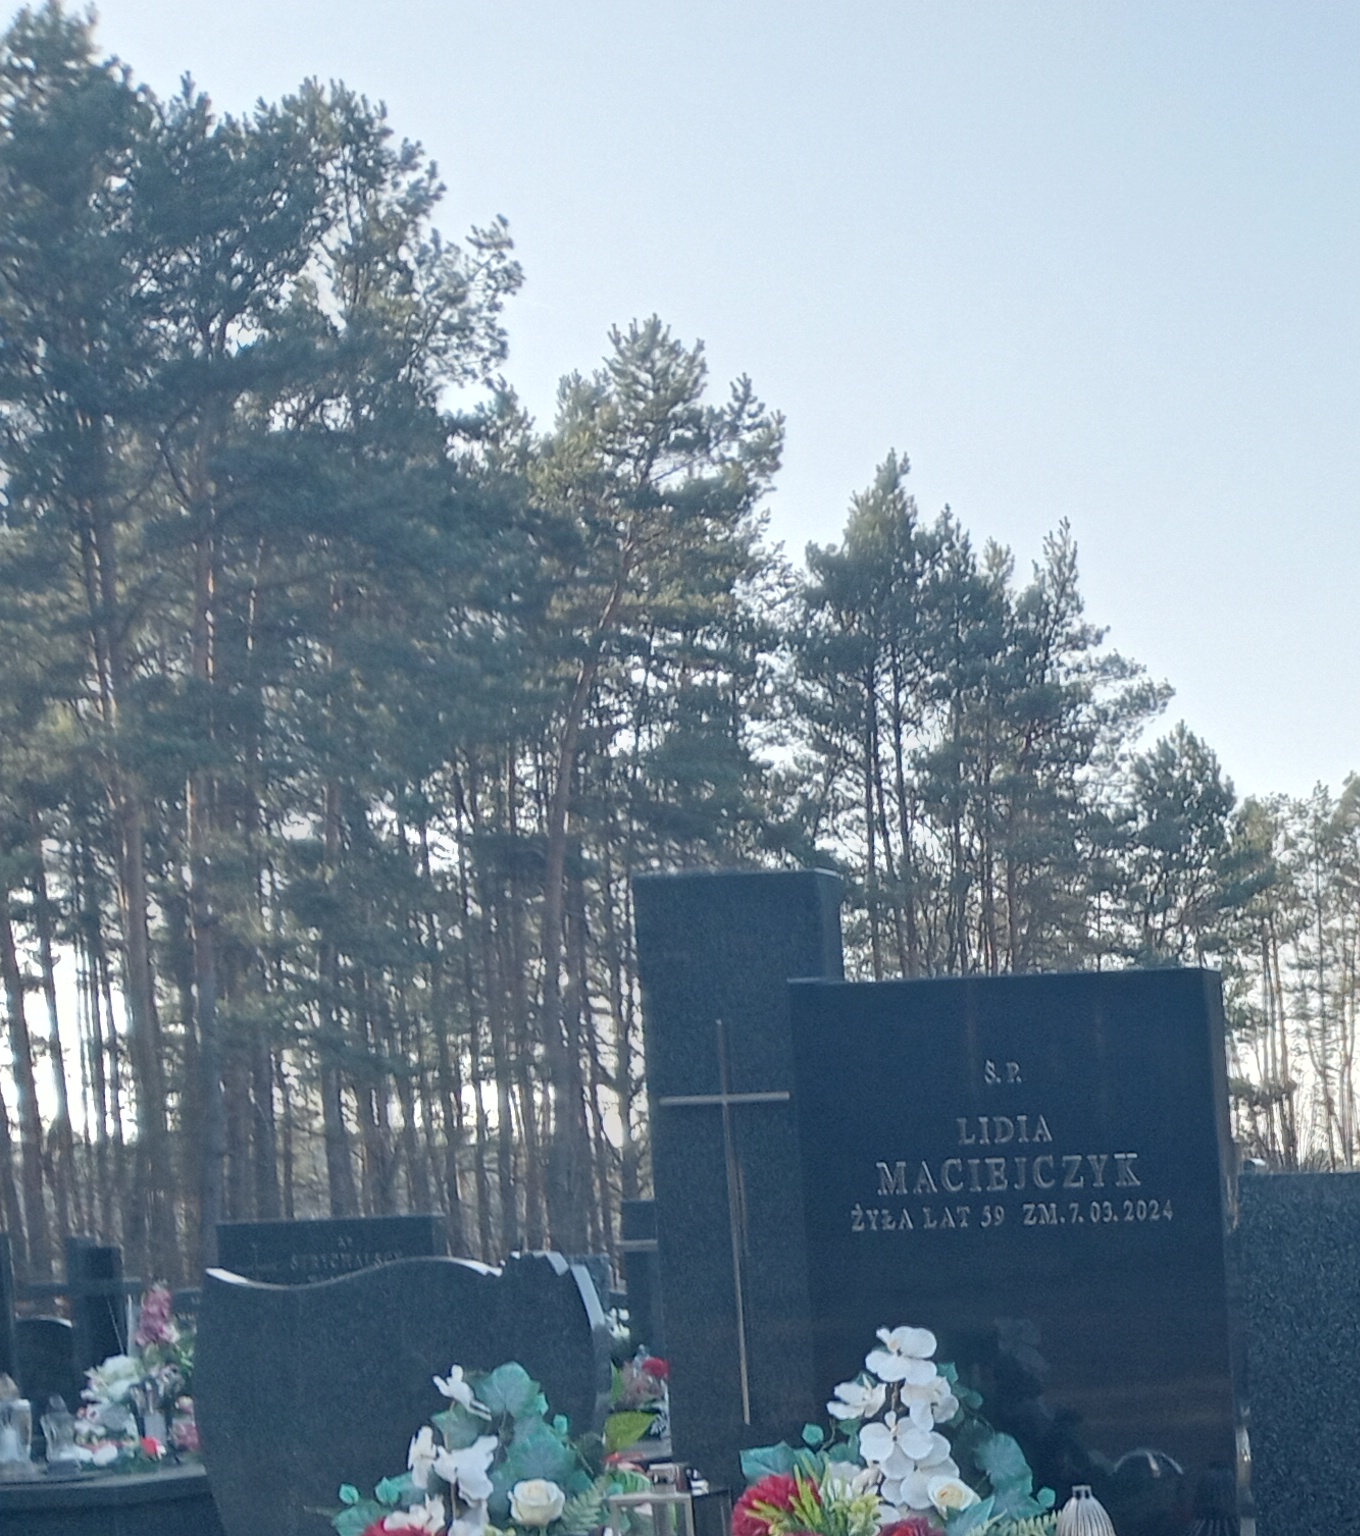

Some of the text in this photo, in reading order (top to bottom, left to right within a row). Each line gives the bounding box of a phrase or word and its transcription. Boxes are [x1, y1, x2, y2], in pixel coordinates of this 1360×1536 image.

[956, 1114, 1053, 1145] LIDIA
[875, 1152, 1142, 1196] MACIEJCZYK
[850, 1202, 914, 1232] ŻYŁA
[923, 1205, 971, 1230] LAT
[980, 1204, 1006, 1228] 59
